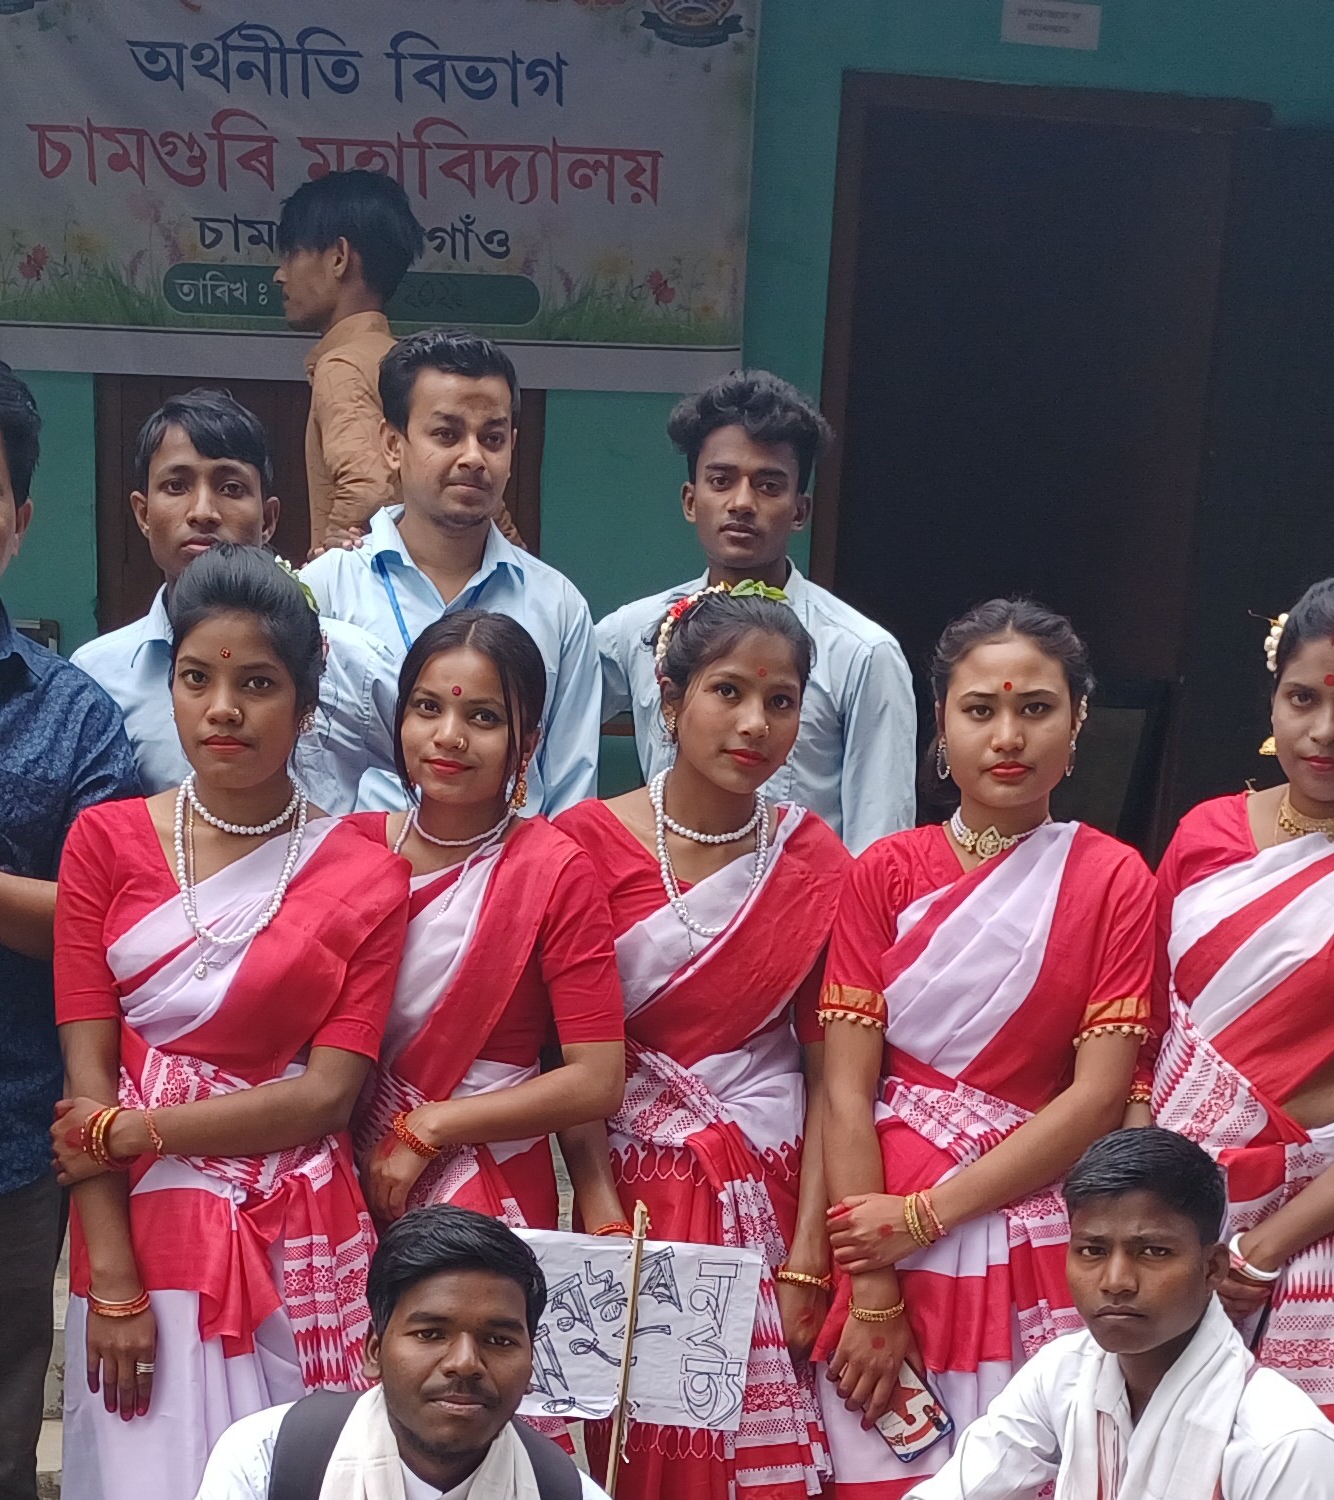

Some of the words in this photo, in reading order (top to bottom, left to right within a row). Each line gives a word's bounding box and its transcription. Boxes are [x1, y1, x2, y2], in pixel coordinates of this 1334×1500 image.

[383, 30, 569, 107] বিভাগ
[26, 109, 278, 191] চামগুৰি
[298, 117, 663, 206] মহাবিদ্যালয়
[192, 213, 280, 254] চাম
[423, 213, 511, 262] গাঁও
[172, 270, 248, 306] তাৰিখ
